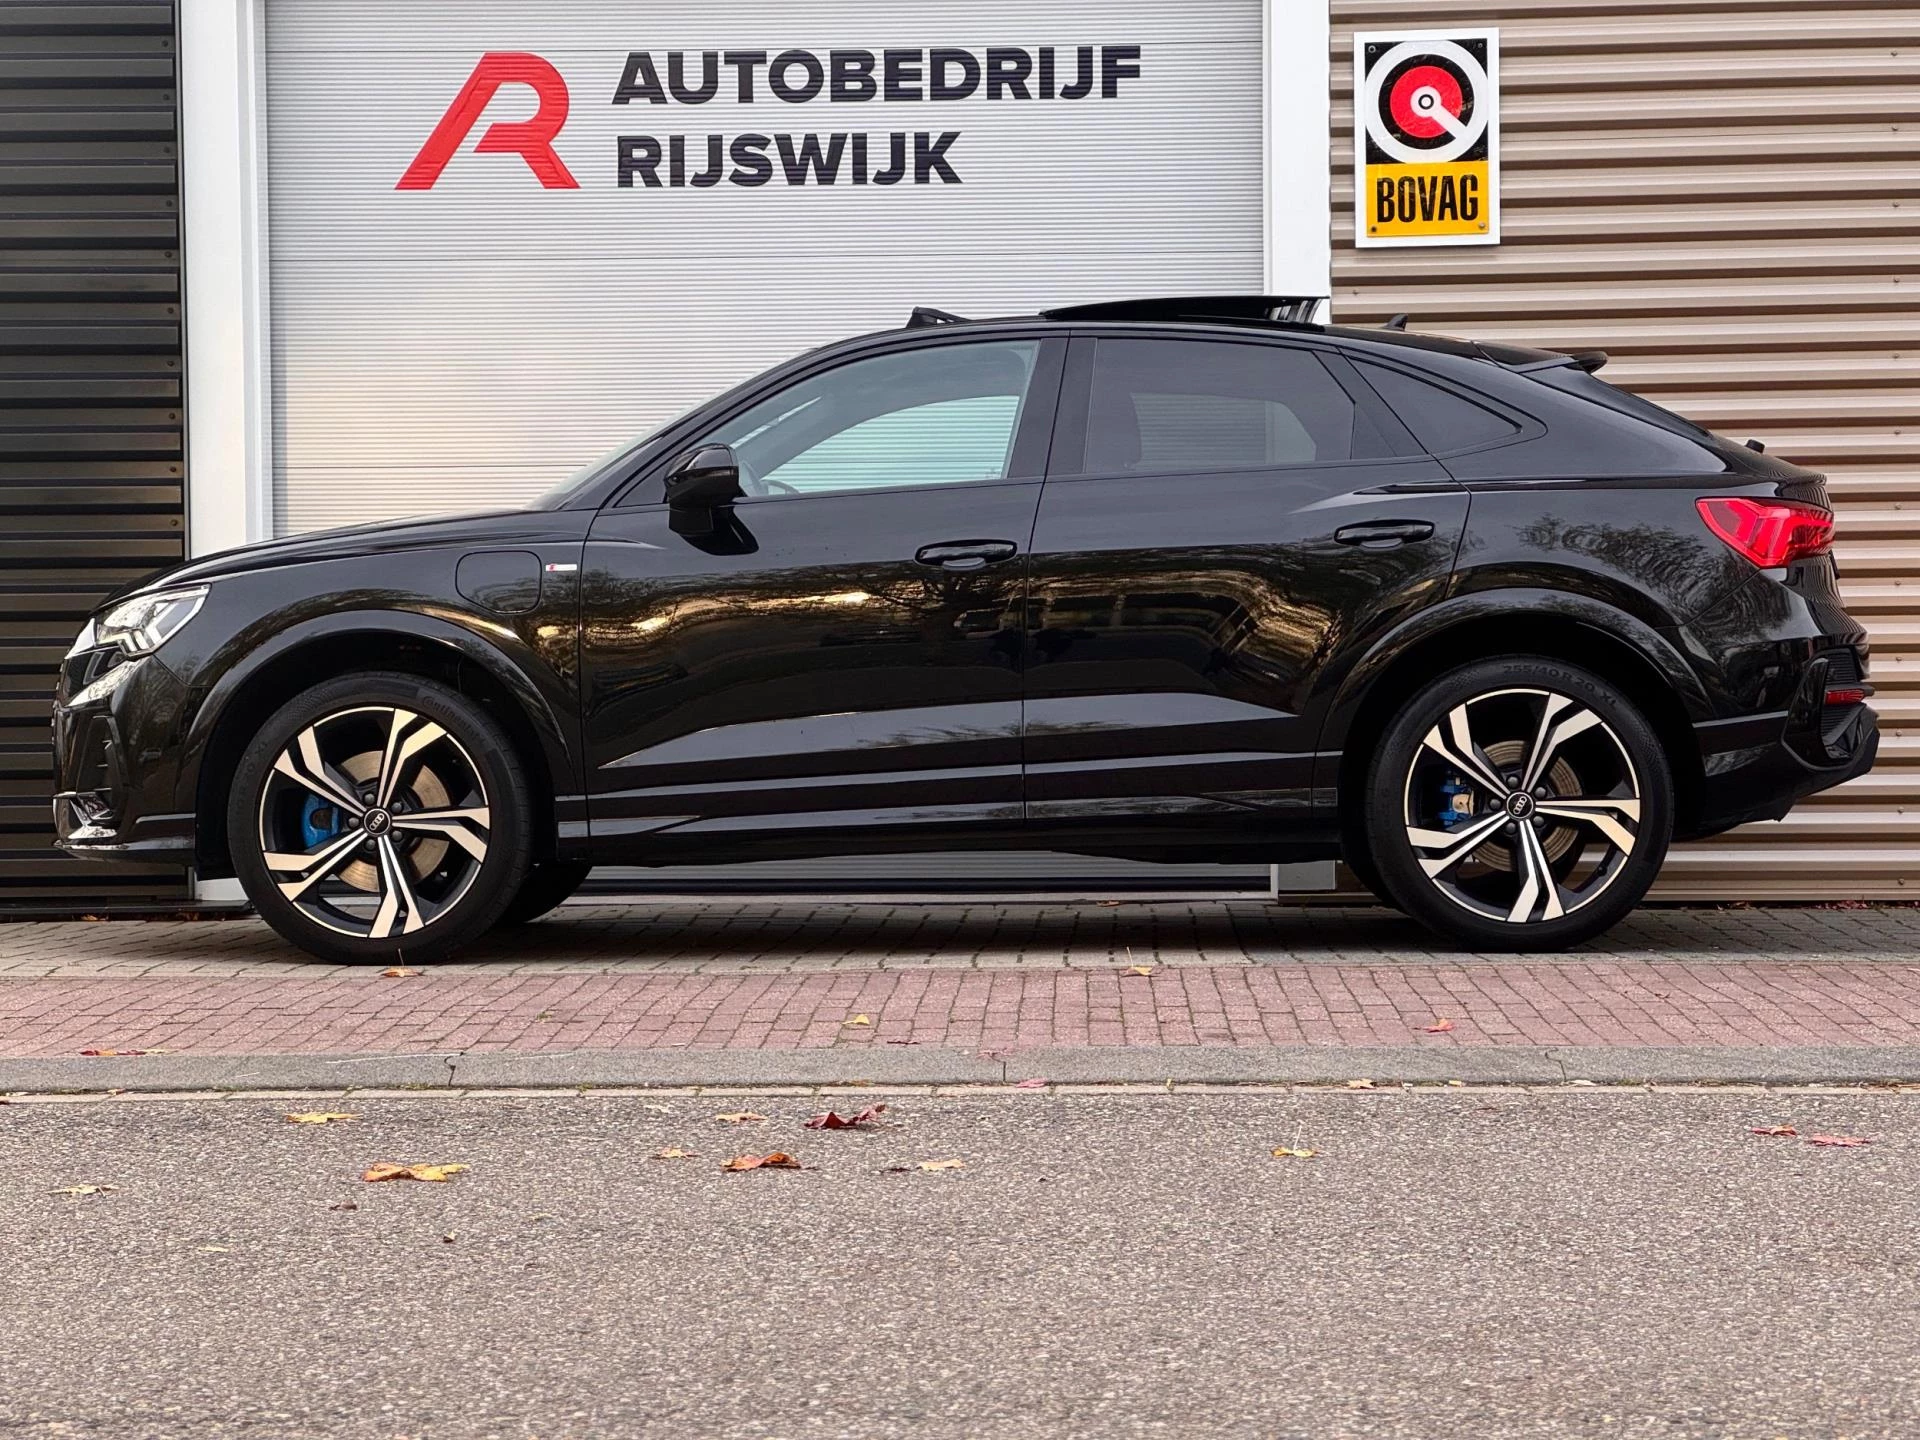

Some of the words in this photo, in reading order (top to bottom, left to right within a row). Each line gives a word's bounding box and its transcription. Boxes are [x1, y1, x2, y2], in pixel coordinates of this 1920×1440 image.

[612, 45, 1141, 105] AUTOBEDRIJF
[617, 131, 963, 188] RIJSWIJK
[1376, 174, 1479, 223] BOVAG
[1503, 664, 1560, 678] 255/40
[1562, 671, 1573, 681] R
[1574, 677, 1596, 693] 20
[1600, 690, 1618, 706] XL
